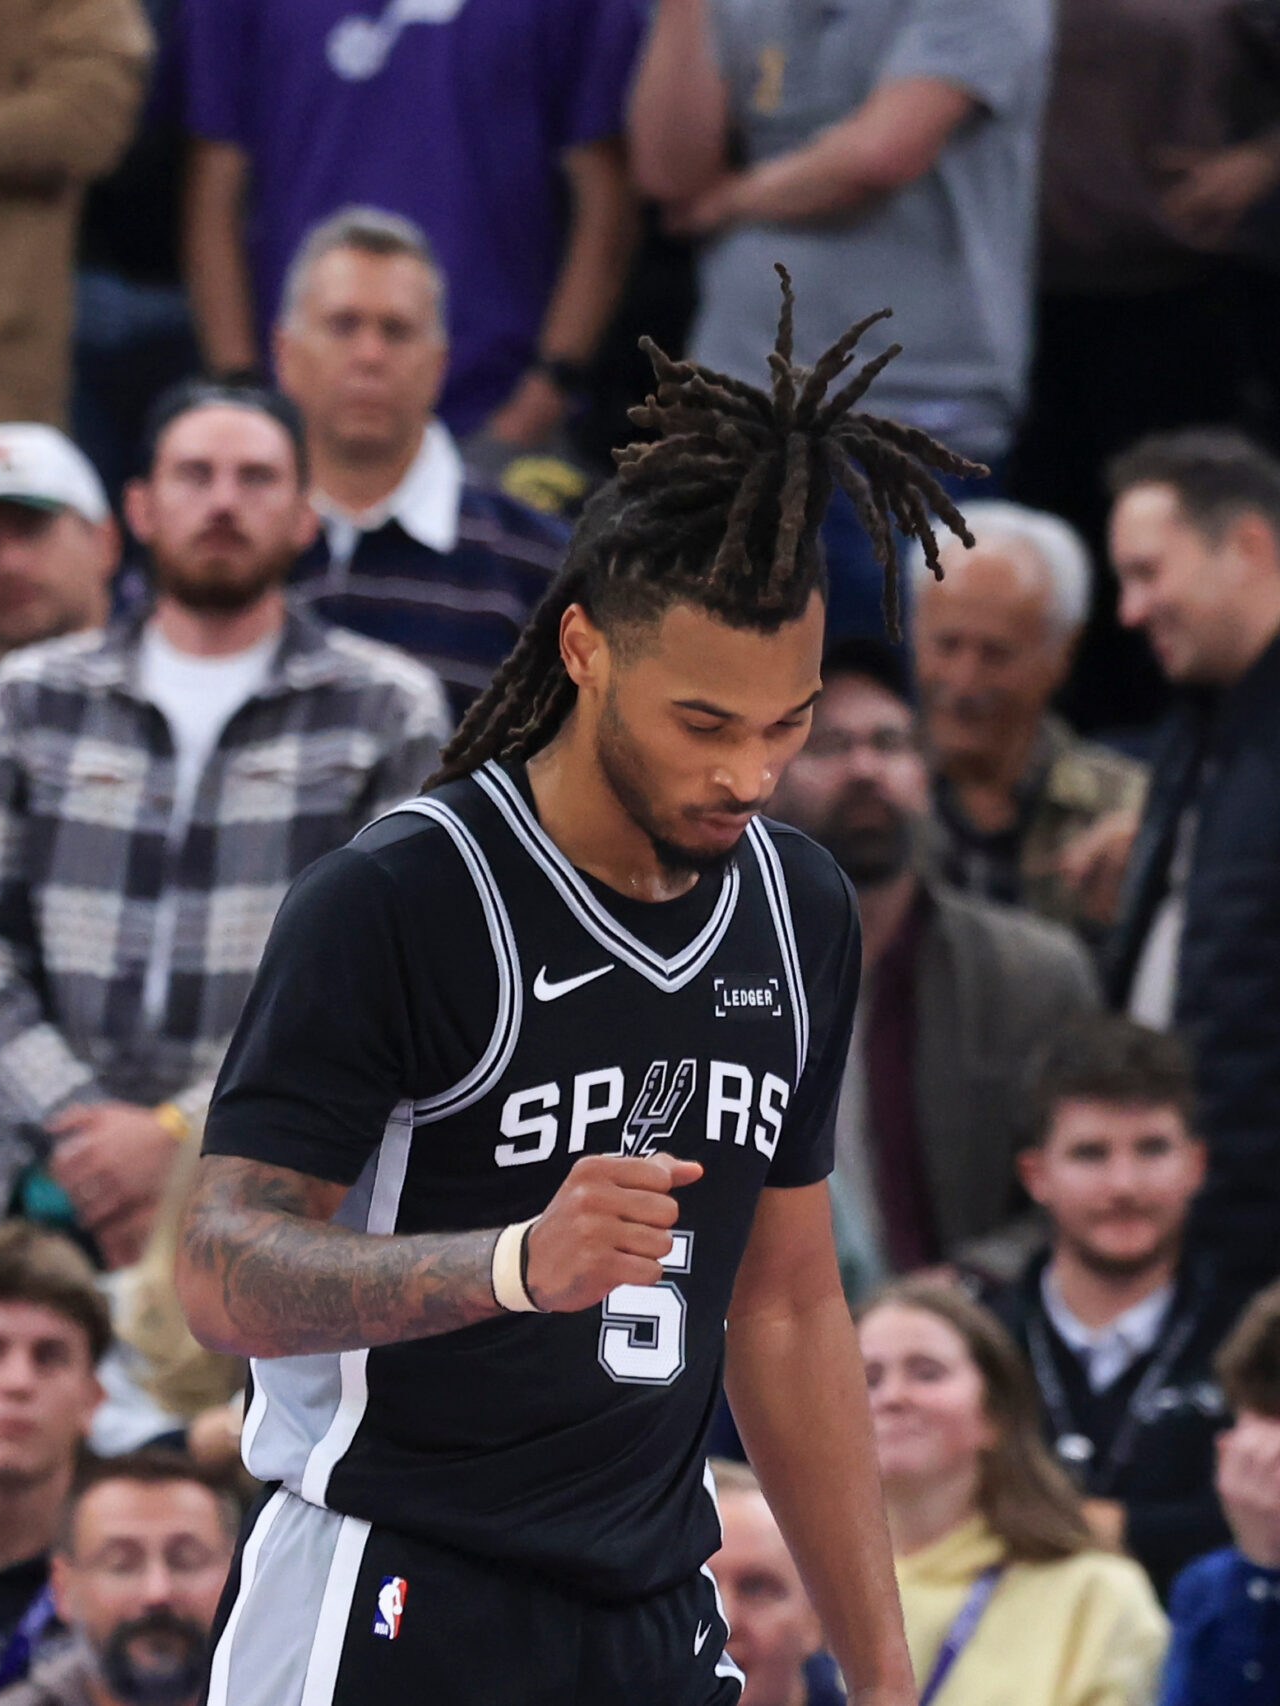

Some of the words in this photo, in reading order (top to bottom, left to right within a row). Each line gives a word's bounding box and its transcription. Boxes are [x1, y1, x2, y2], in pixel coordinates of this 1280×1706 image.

[723, 989, 773, 1006] LEDGER
[494, 1058, 789, 1168] SPURS
[597, 1229, 695, 1386] 5
